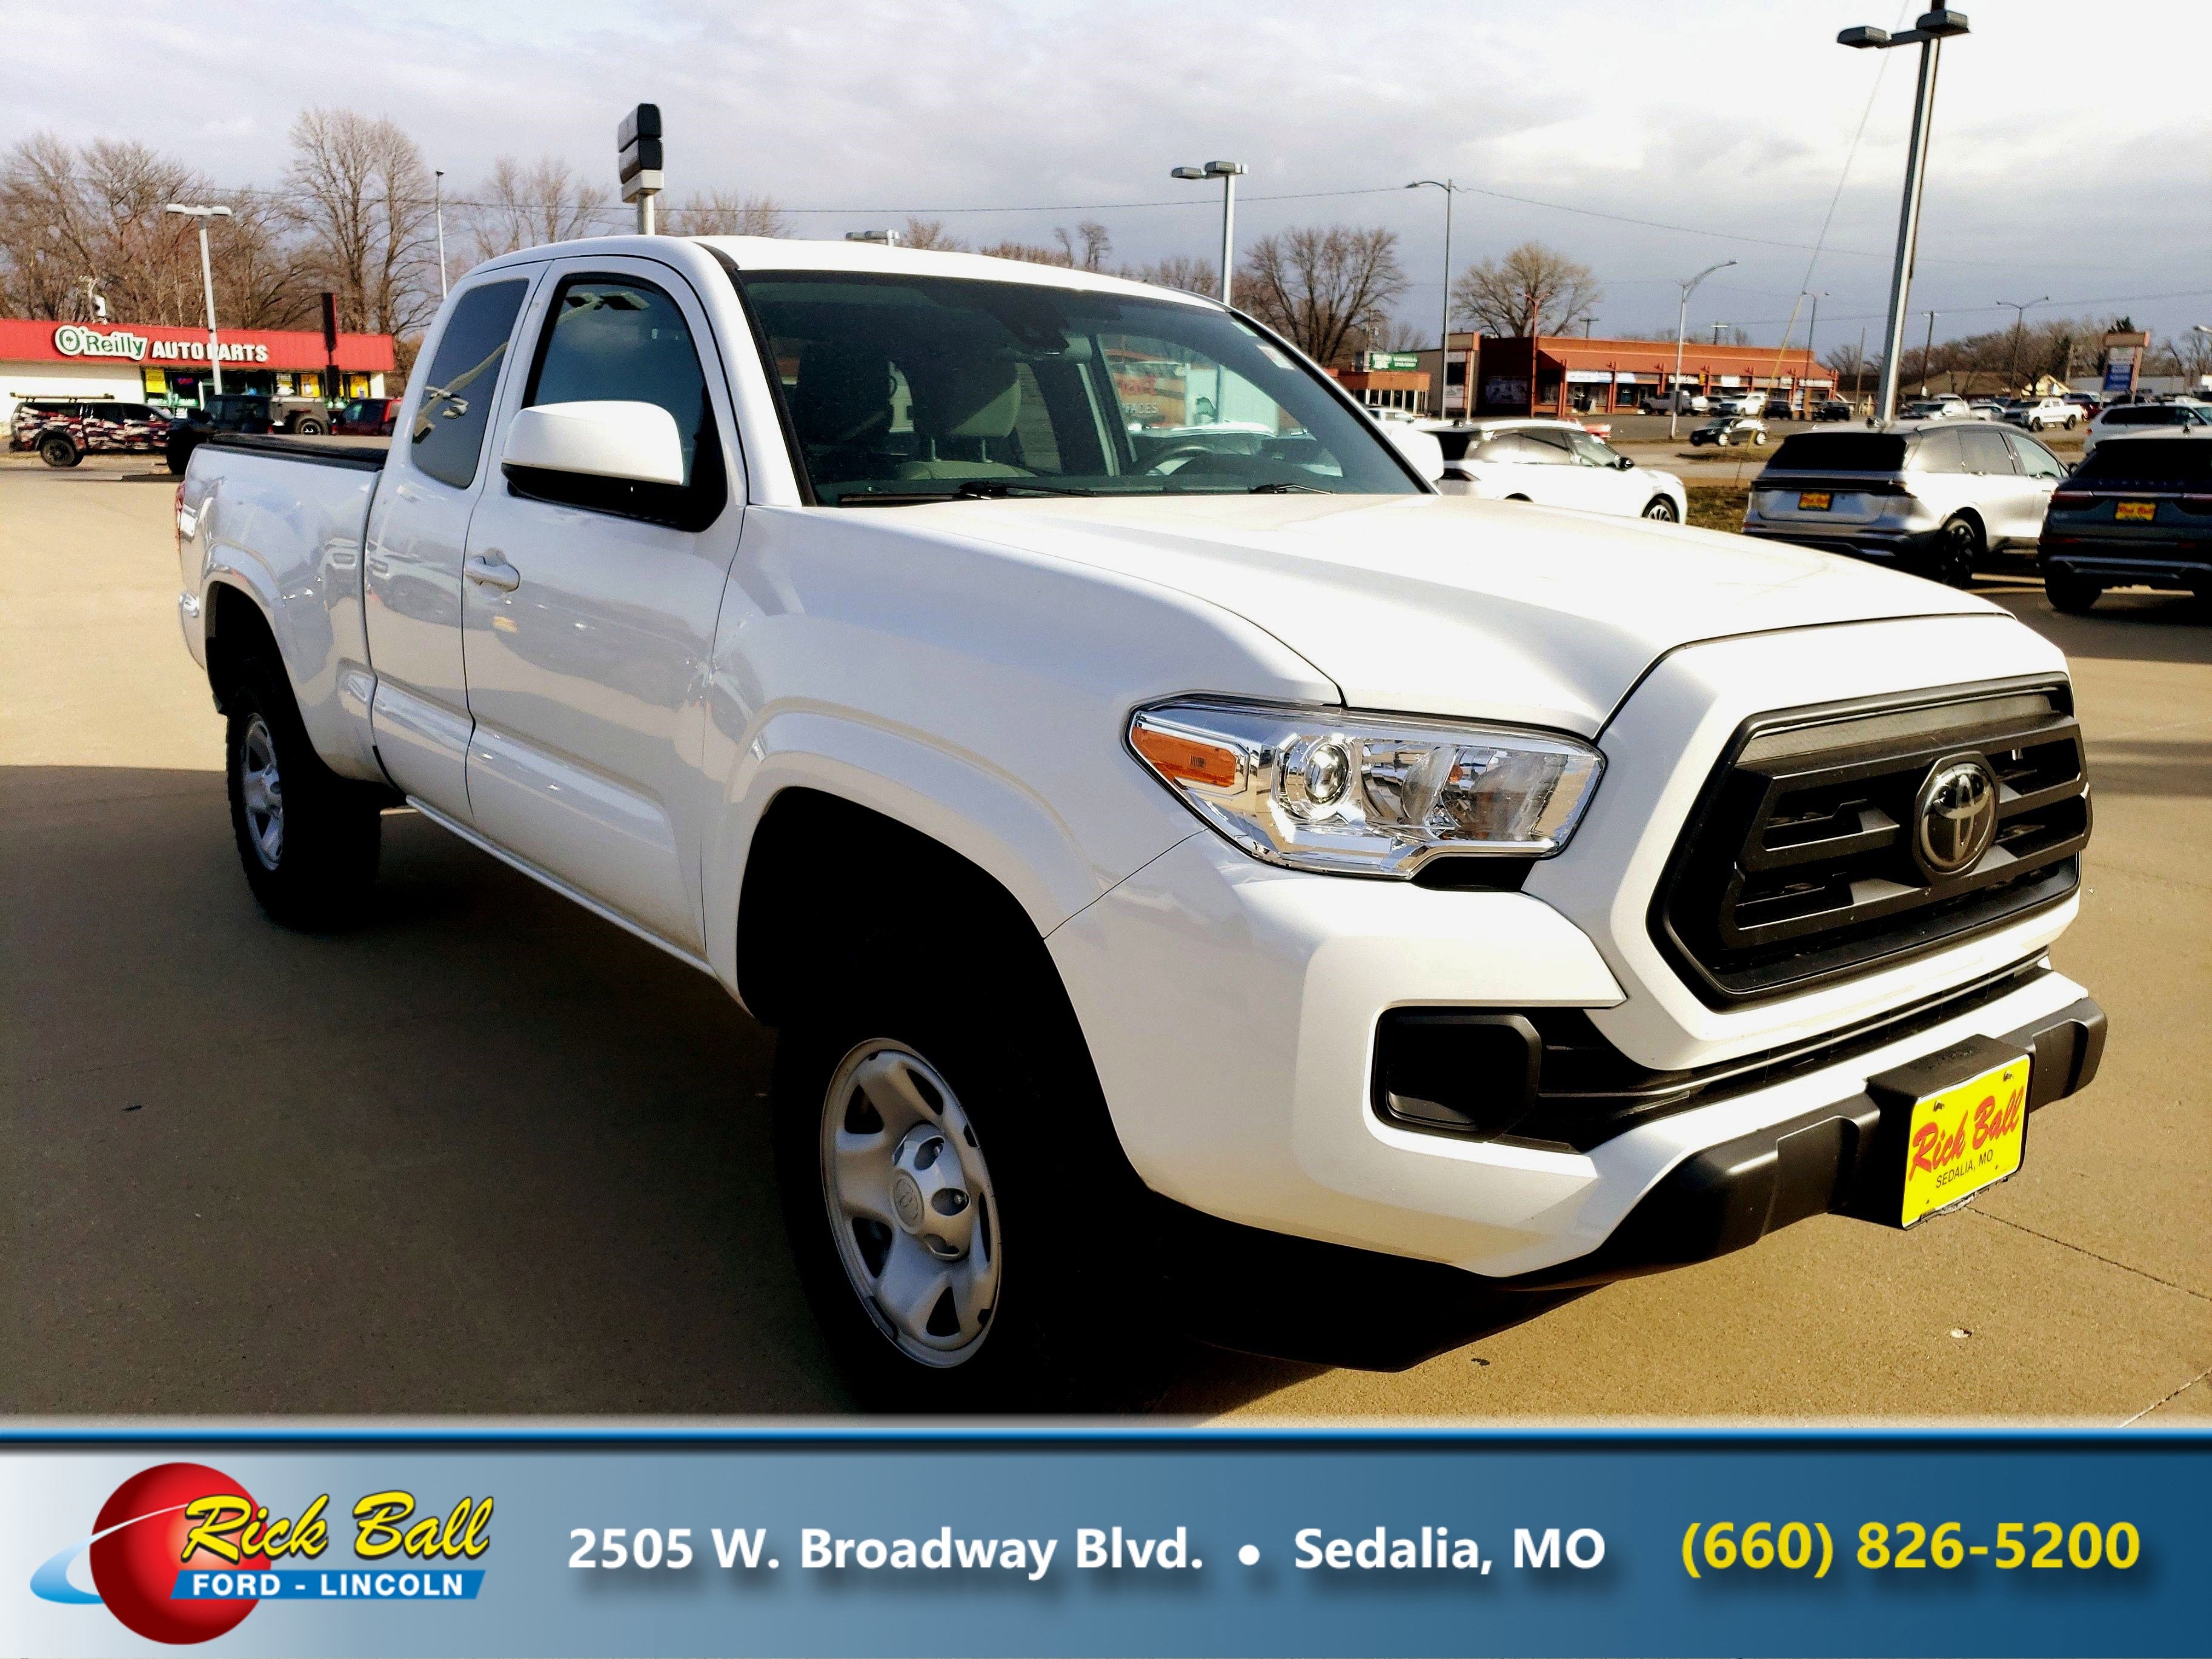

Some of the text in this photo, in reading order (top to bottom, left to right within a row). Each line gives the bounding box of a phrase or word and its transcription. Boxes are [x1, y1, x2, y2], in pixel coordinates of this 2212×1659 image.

[59, 328, 144, 356] O'Reilly
[152, 340, 204, 360] AUTO
[1908, 1085, 2024, 1181] Rick Ball
[1936, 1149, 1994, 1188] SEDALIA, MO
